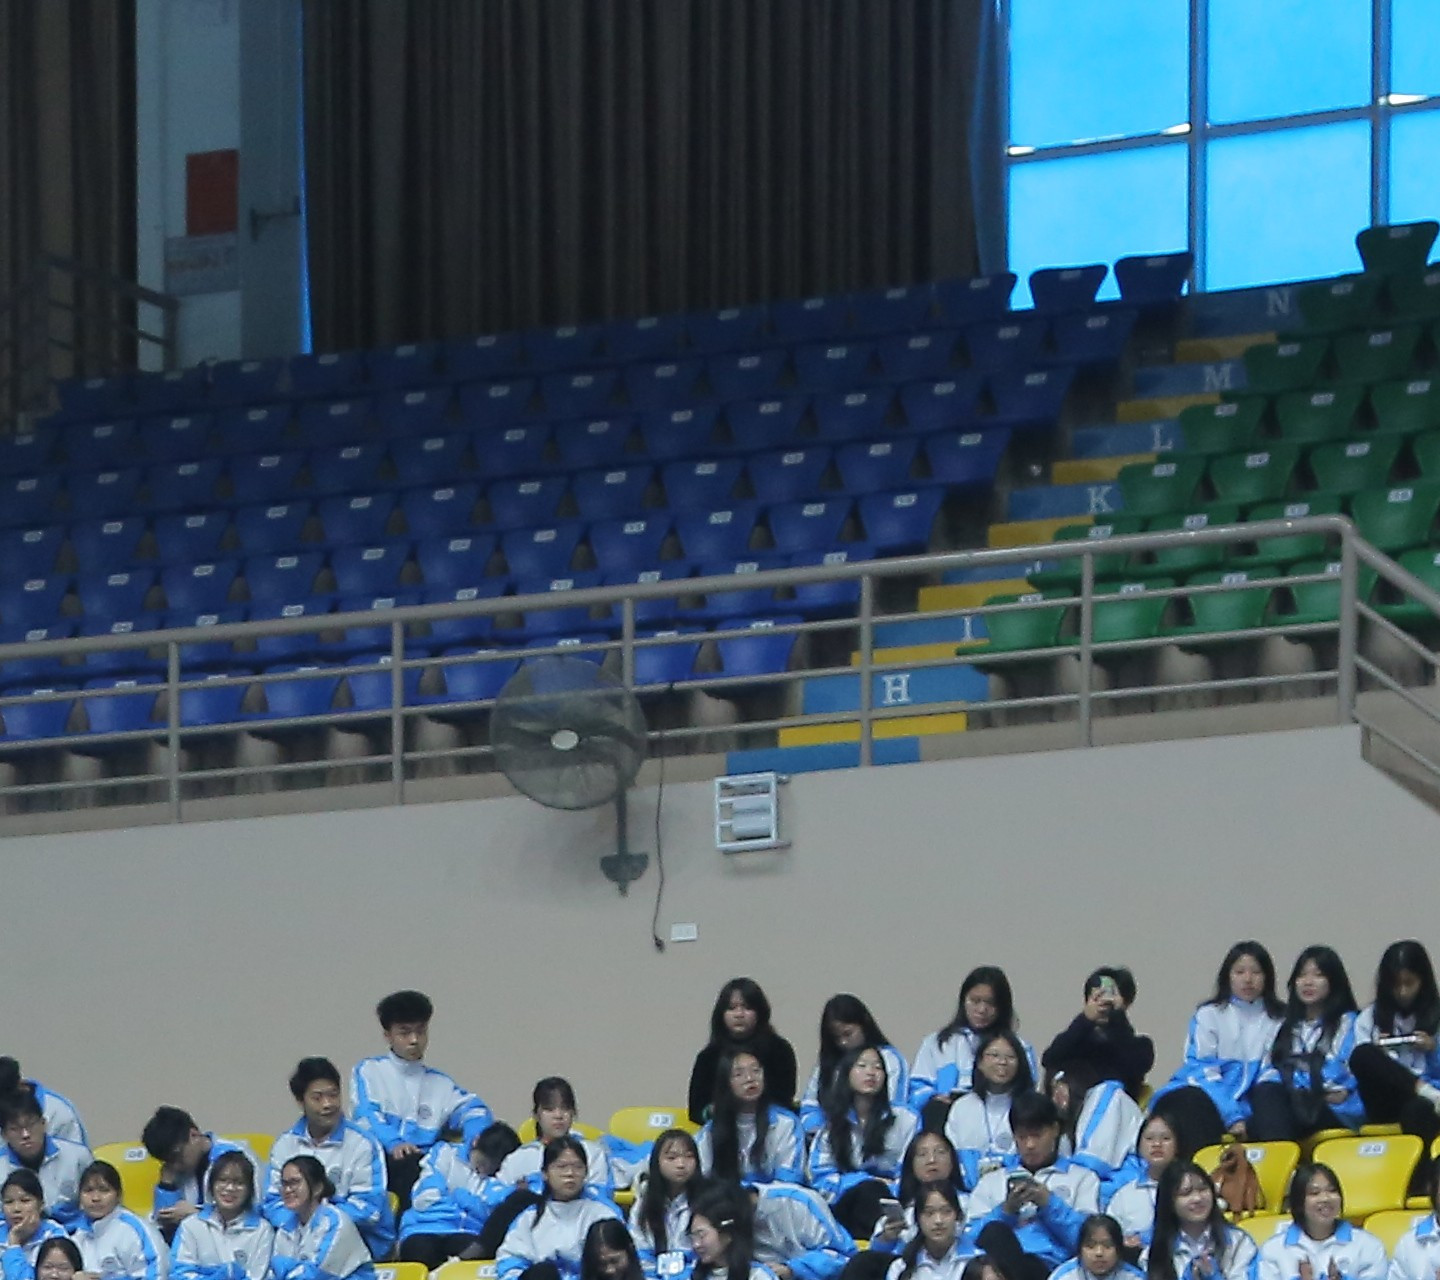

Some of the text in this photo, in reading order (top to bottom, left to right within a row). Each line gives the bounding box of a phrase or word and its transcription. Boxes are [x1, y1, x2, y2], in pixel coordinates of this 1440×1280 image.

[1152, 424, 1172, 451] L
[1088, 484, 1112, 514] K
[882, 673, 911, 704] H
